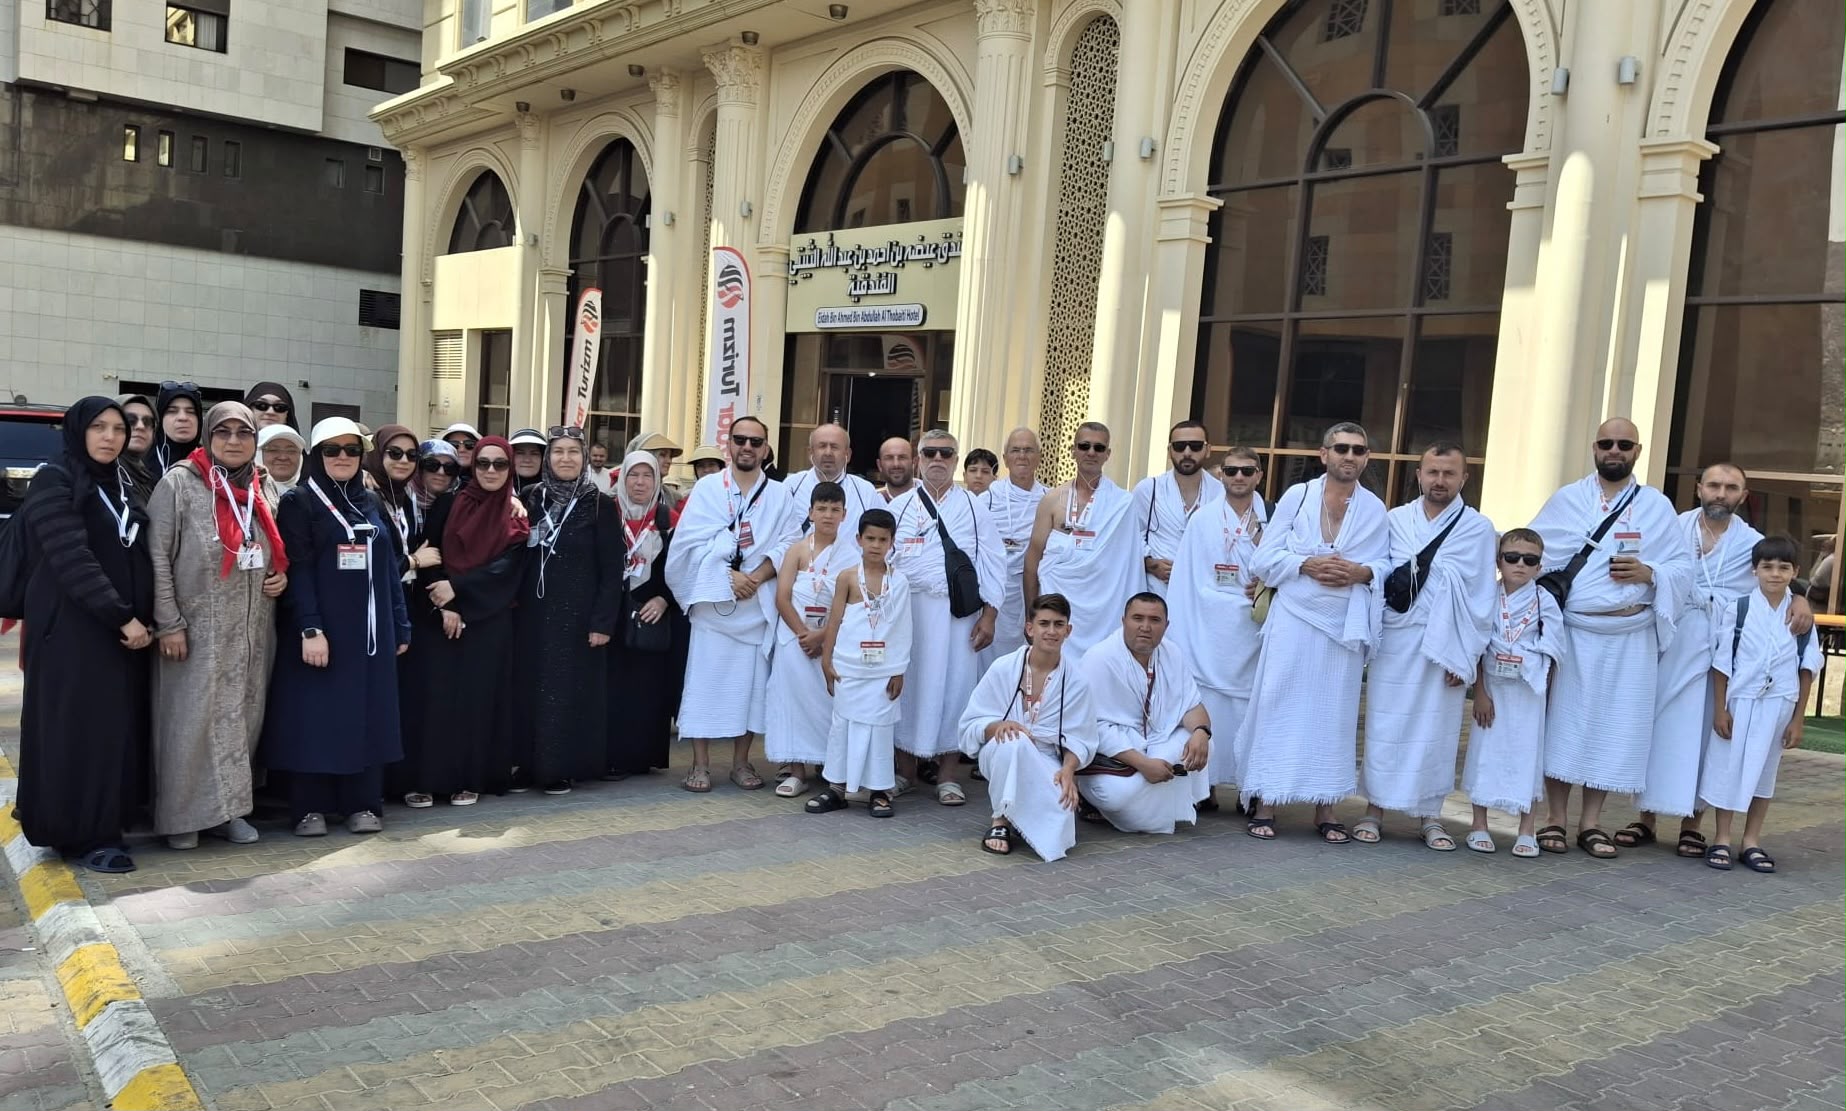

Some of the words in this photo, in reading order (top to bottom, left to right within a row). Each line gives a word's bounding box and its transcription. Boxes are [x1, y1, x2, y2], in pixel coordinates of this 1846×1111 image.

[938, 232, 963, 264] ندق
[838, 311, 852, 323] Ahmed
[861, 309, 880, 322] Abdullah
[906, 308, 920, 321] Hotel
[577, 339, 593, 400] Turizm
